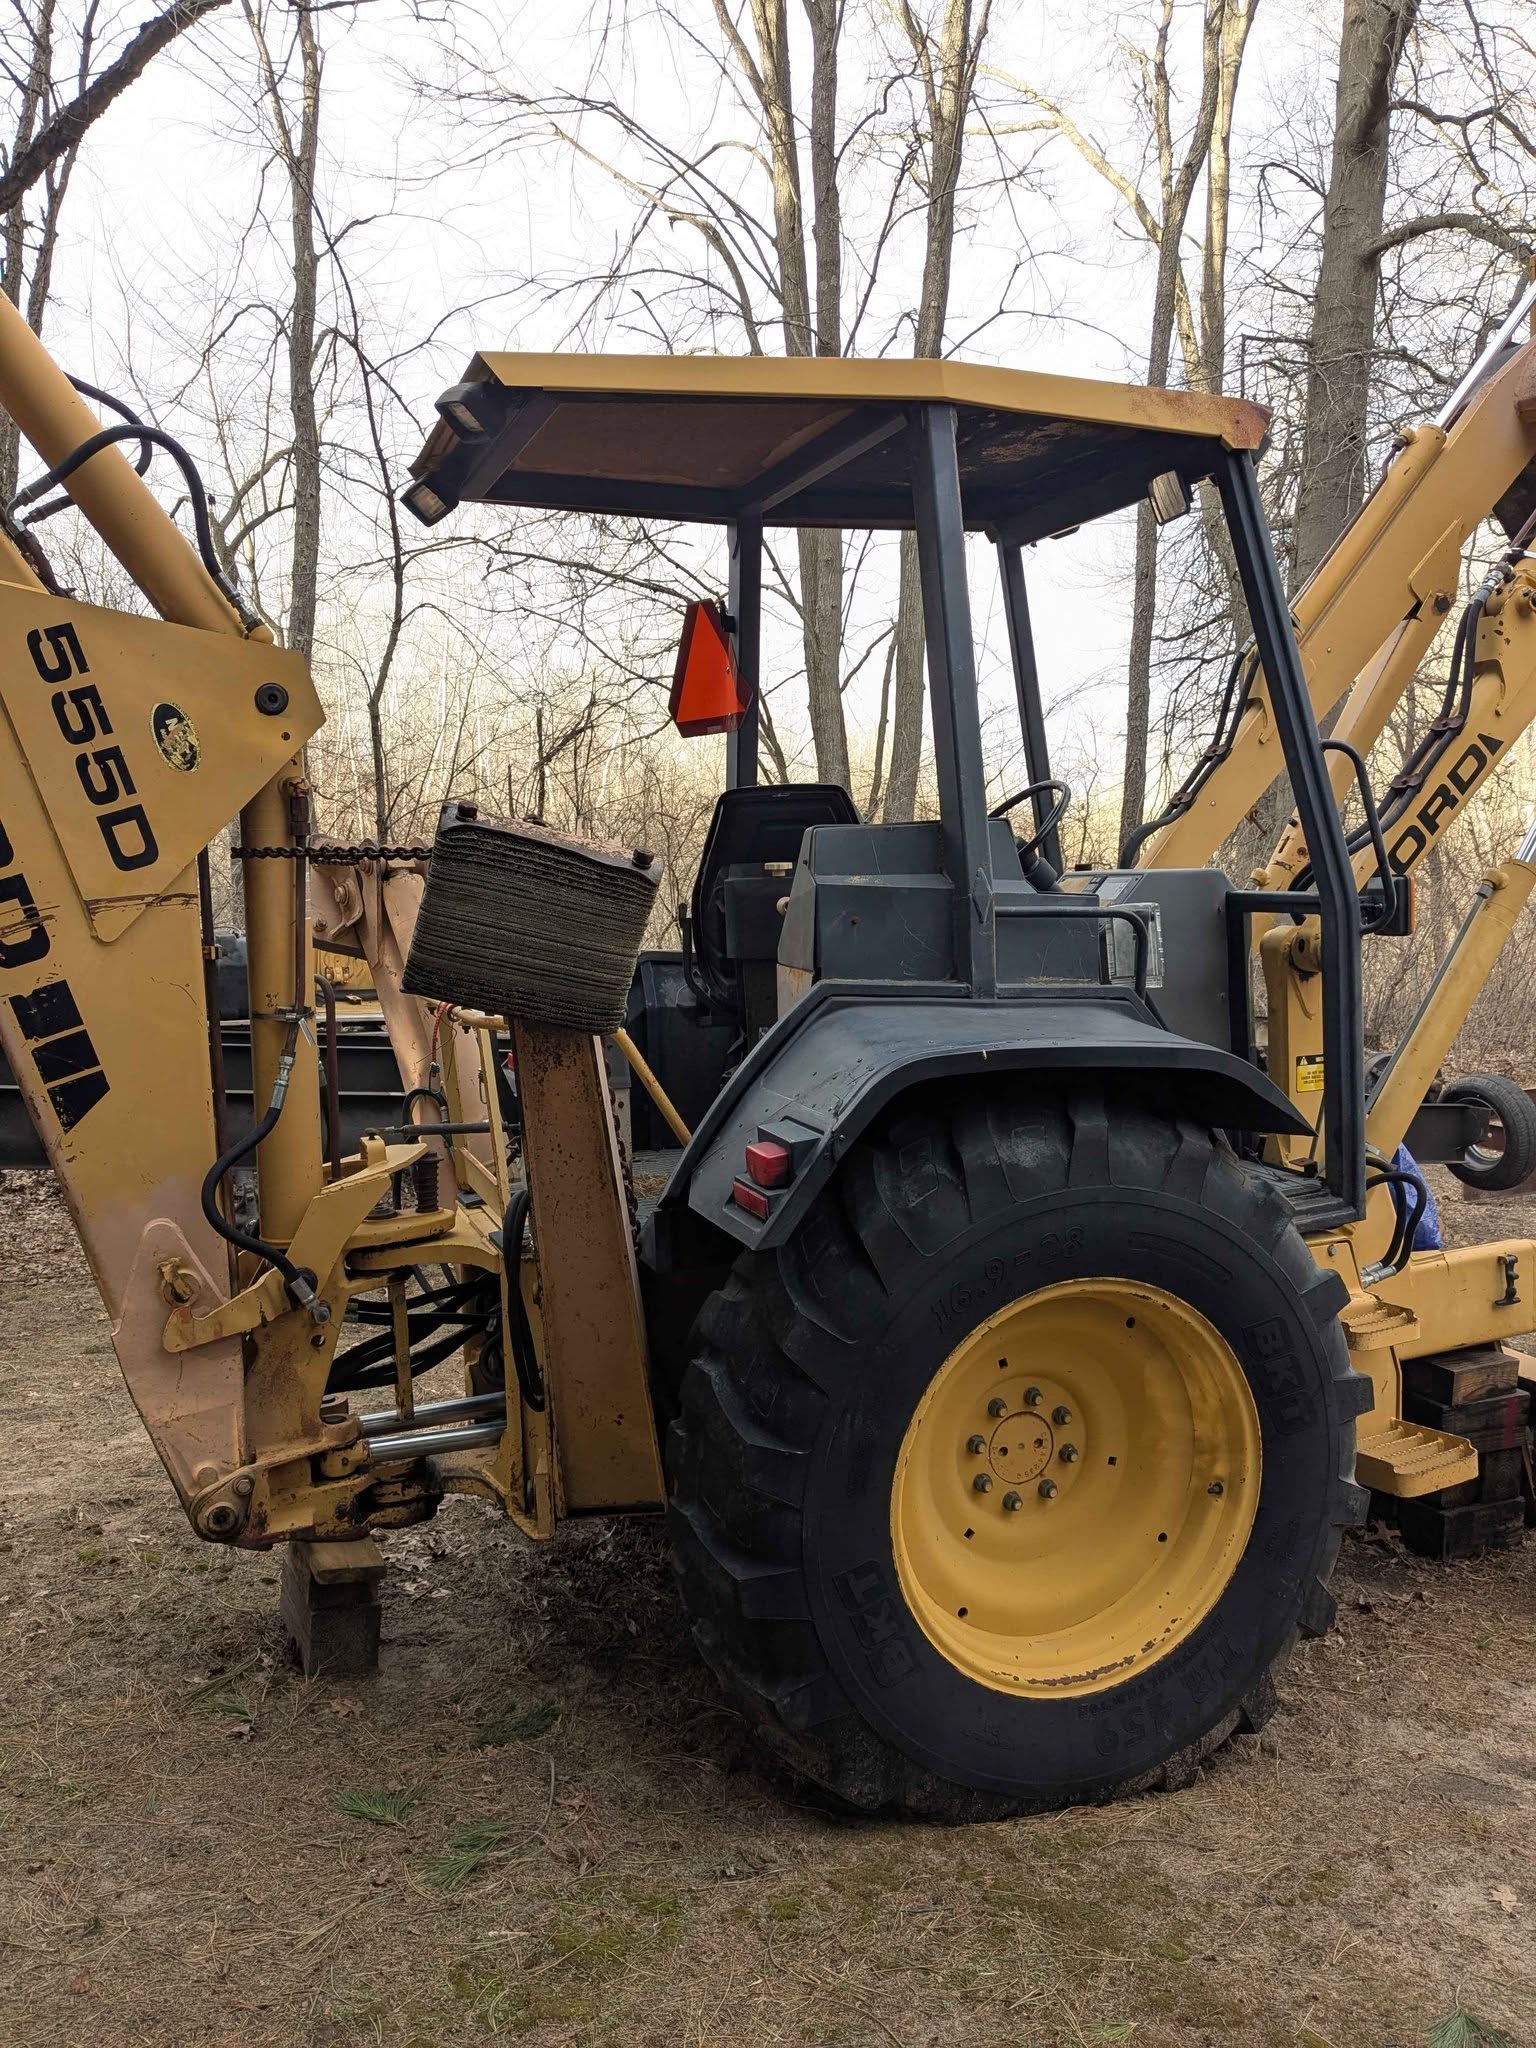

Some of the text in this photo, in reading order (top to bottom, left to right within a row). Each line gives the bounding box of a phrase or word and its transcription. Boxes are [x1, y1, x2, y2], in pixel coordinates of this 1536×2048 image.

[27, 622, 159, 872] 555D
[1372, 743, 1488, 881] ORD
[1250, 1319, 1315, 1431] BKT
[842, 1566, 917, 1686] BKT
